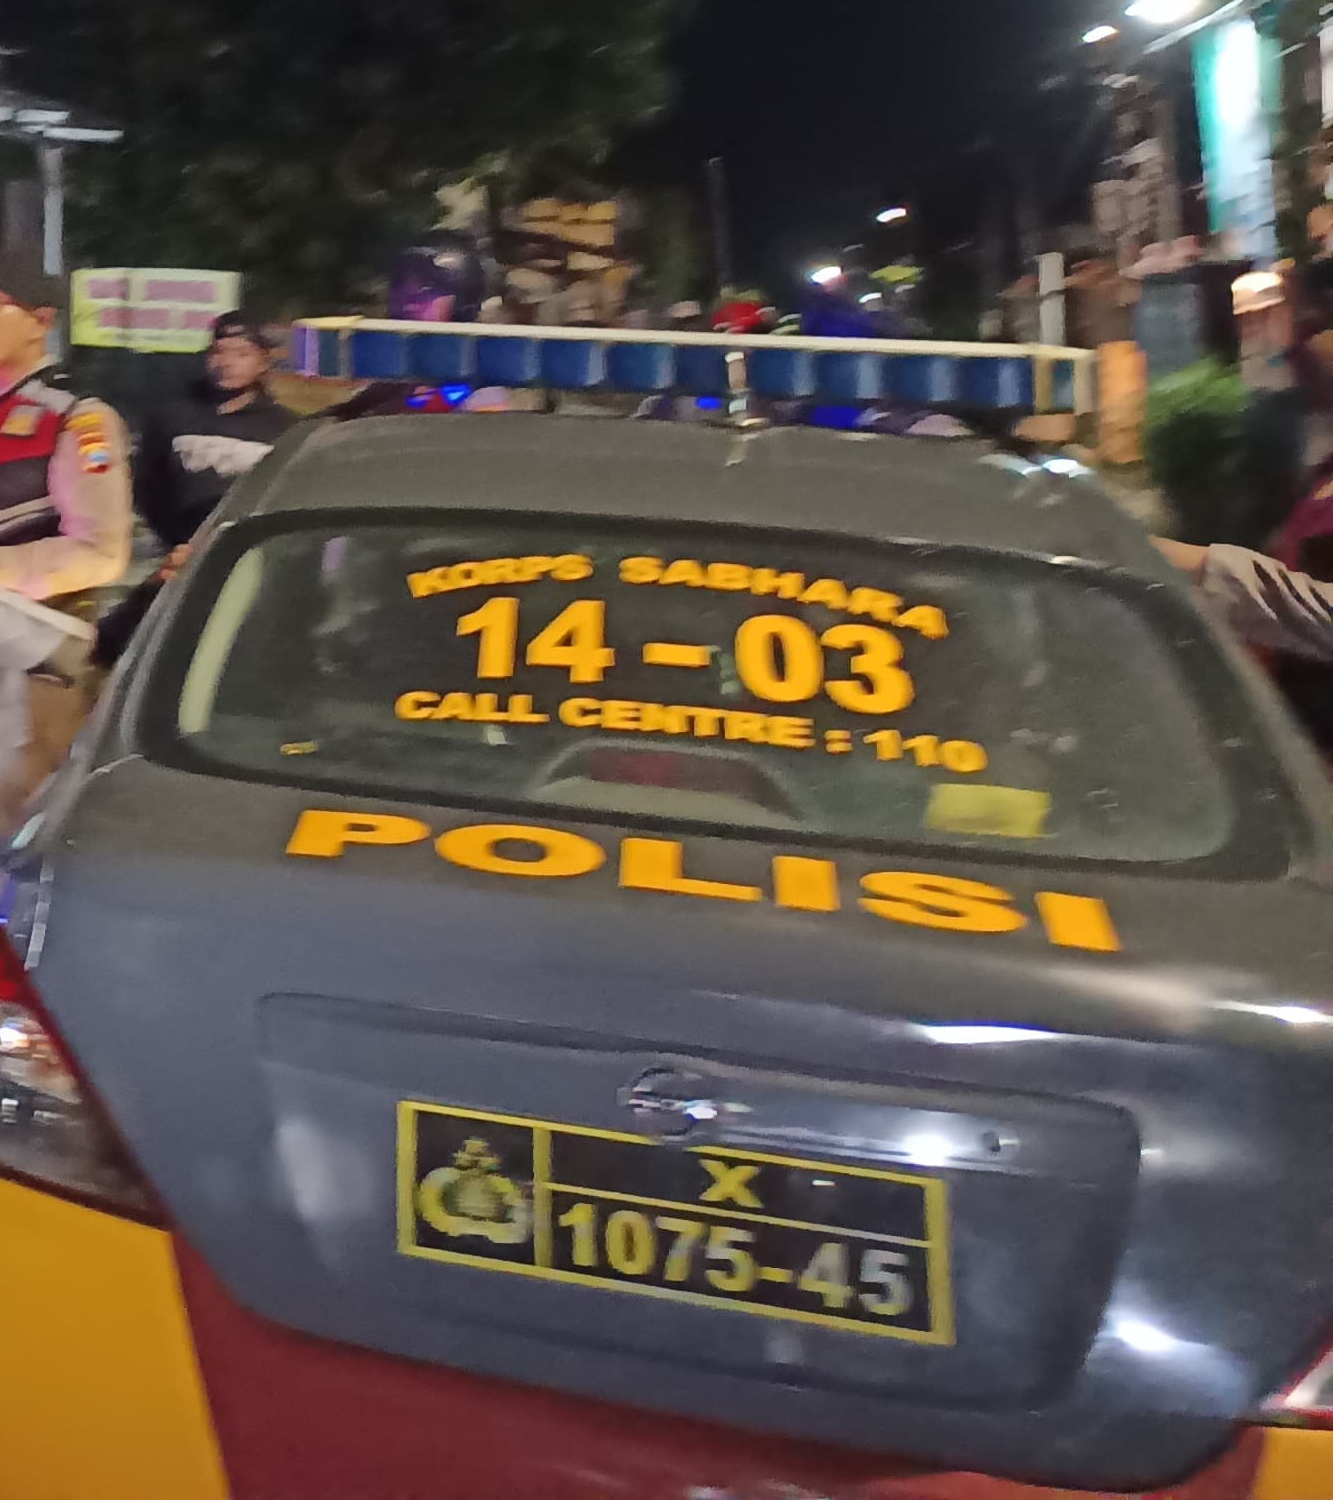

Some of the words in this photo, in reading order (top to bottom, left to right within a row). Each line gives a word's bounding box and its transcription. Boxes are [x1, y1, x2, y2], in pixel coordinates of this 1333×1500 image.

[407, 555, 593, 598] KORPS
[619, 557, 948, 638] SABHARA
[457, 597, 615, 683] 14
[735, 615, 915, 714] 03
[395, 691, 549, 723] CALL
[559, 698, 816, 748] CENTRE
[863, 730, 988, 772] 110
[286, 810, 1121, 951] POLISI
[699, 1159, 764, 1208] X
[560, 1203, 915, 1316] 1075-45
